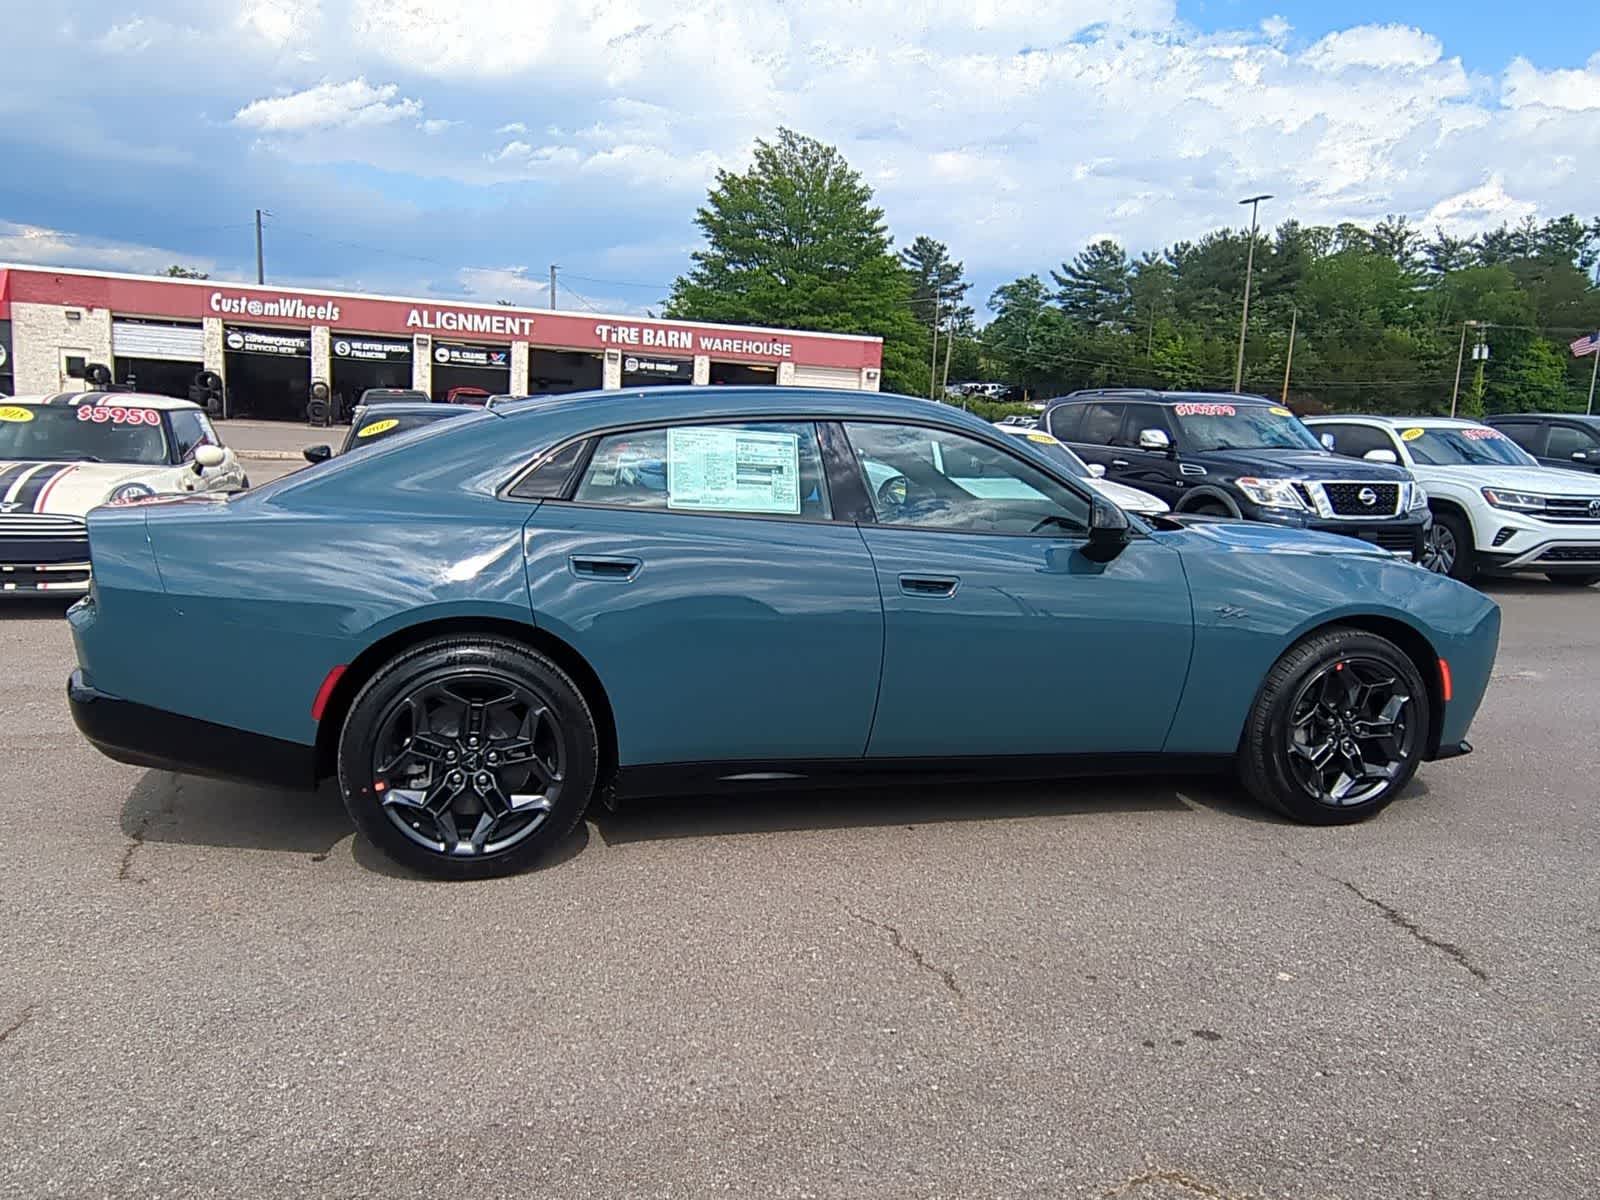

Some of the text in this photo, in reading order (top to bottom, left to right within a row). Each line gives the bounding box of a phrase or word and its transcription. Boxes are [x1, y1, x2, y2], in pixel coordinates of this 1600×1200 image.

[406, 309, 534, 336] ALIGNMENT
[643, 329, 693, 349] BARN
[700, 337, 792, 357] WAREHOUSE
[77, 404, 161, 426] $5950
